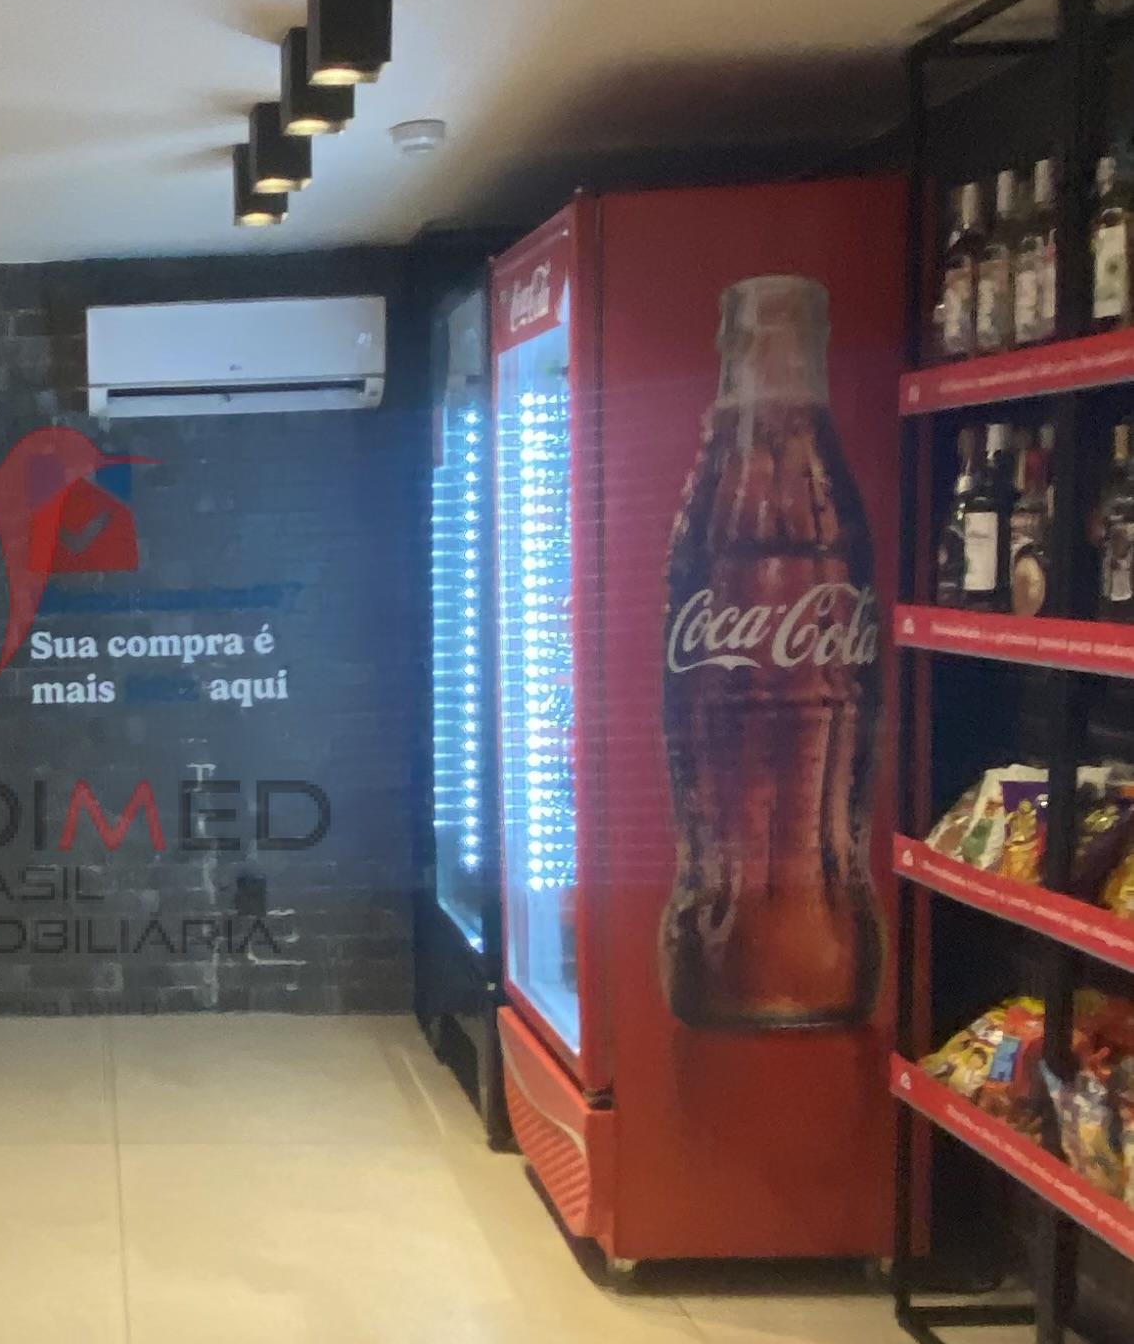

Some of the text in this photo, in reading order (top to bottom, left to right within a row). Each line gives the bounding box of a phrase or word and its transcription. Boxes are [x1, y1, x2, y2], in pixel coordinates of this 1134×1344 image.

[30, 623, 275, 664] Sua compra é
[667, 583, 877, 673] Coca-Cola
[31, 669, 288, 707] mais aqui
